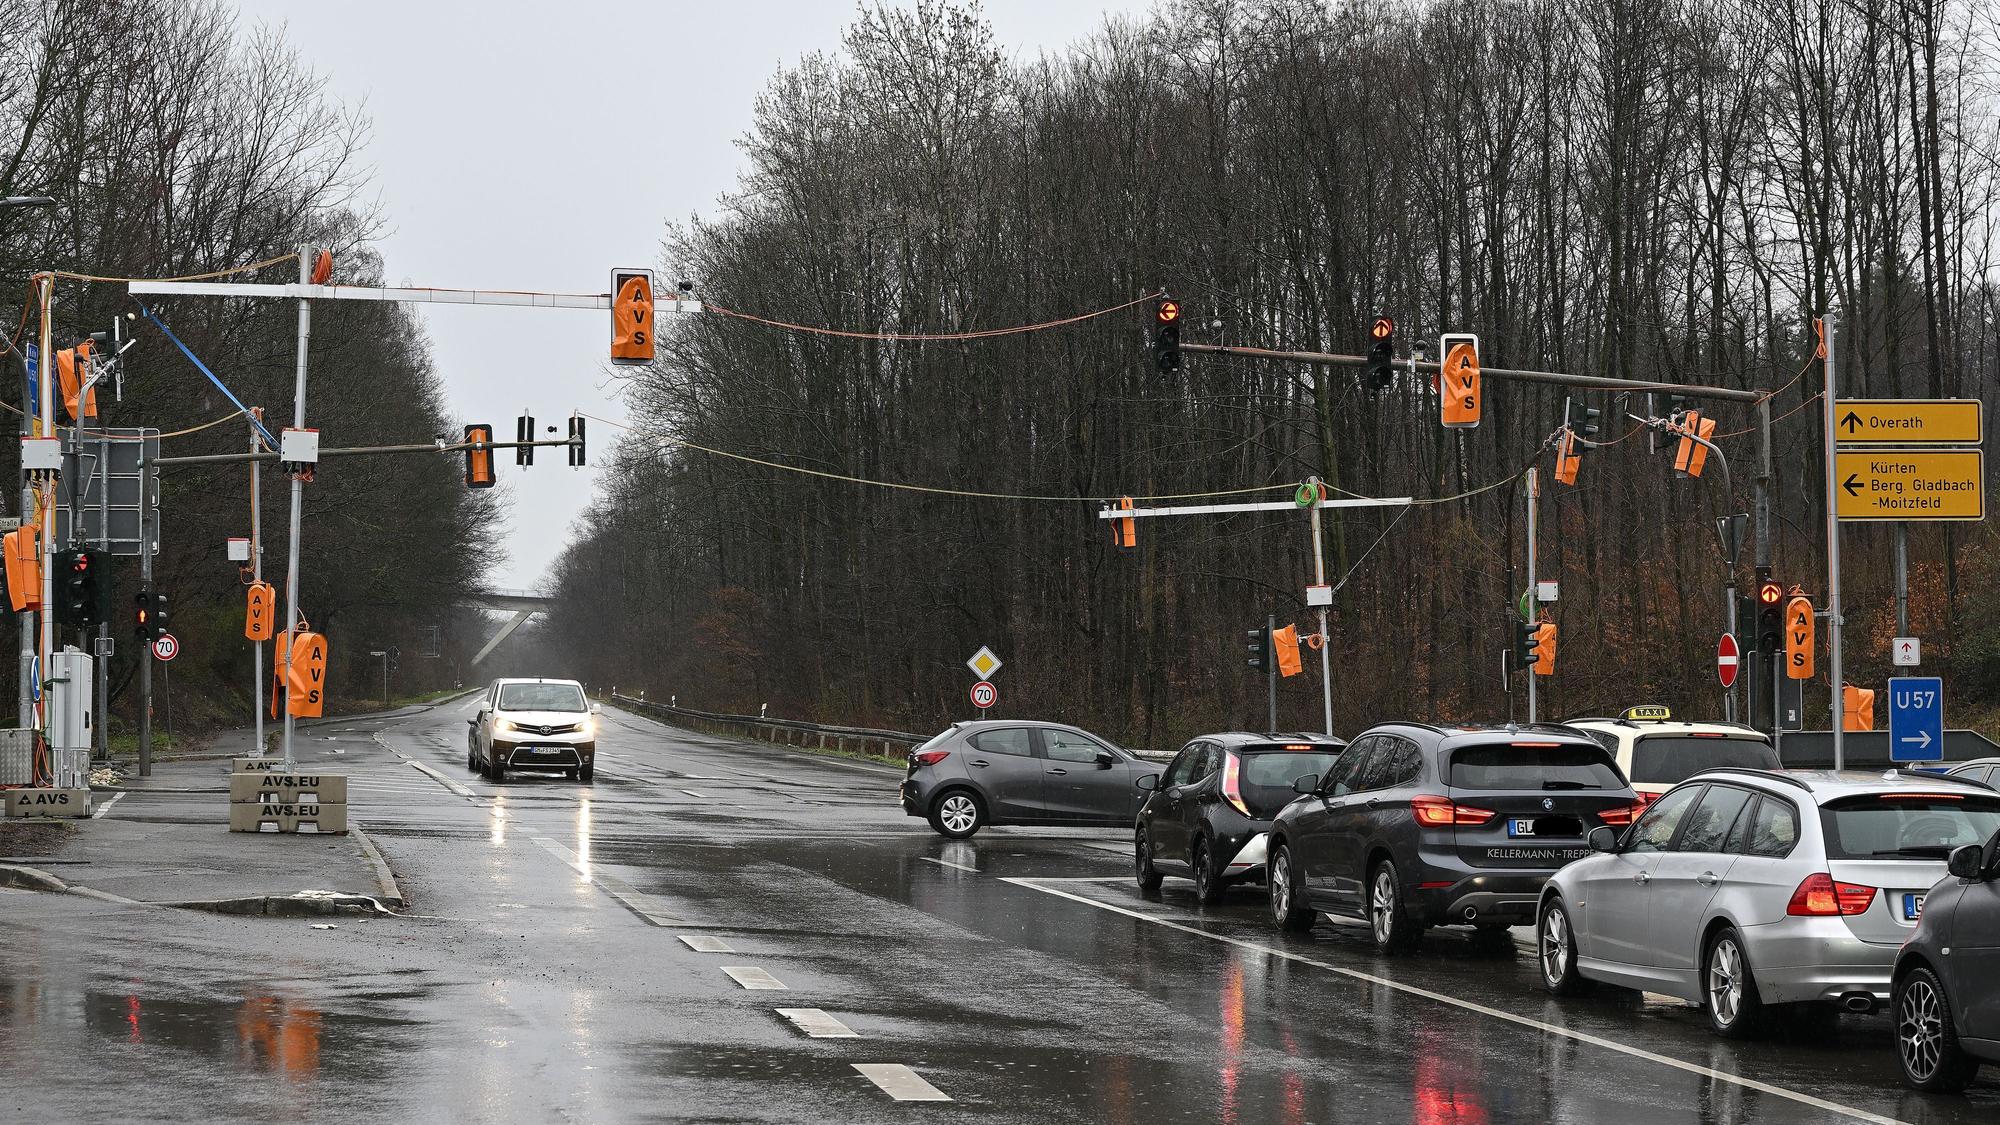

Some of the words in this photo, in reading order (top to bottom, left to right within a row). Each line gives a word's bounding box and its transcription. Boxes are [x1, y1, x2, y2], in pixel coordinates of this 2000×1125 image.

[632, 288, 646, 345] AVS
[1460, 355, 1475, 410] AVS
[1869, 416, 1923, 429] Overath
[1870, 461, 1916, 474] Kürten
[1871, 479, 1907, 494] Berg.
[1912, 479, 1975, 491] Gladbach
[1871, 496, 1941, 509] -Moitzfeld
[252, 595, 262, 632] AVS
[1793, 612, 1807, 667] AVS
[158, 641, 172, 653] 70
[308, 646, 322, 704] AVS
[977, 689, 991, 701] 70
[262, 776, 320, 787] AVS.EU
[36, 793, 69, 805] AVS
[262, 805, 320, 816] AVS.EU
